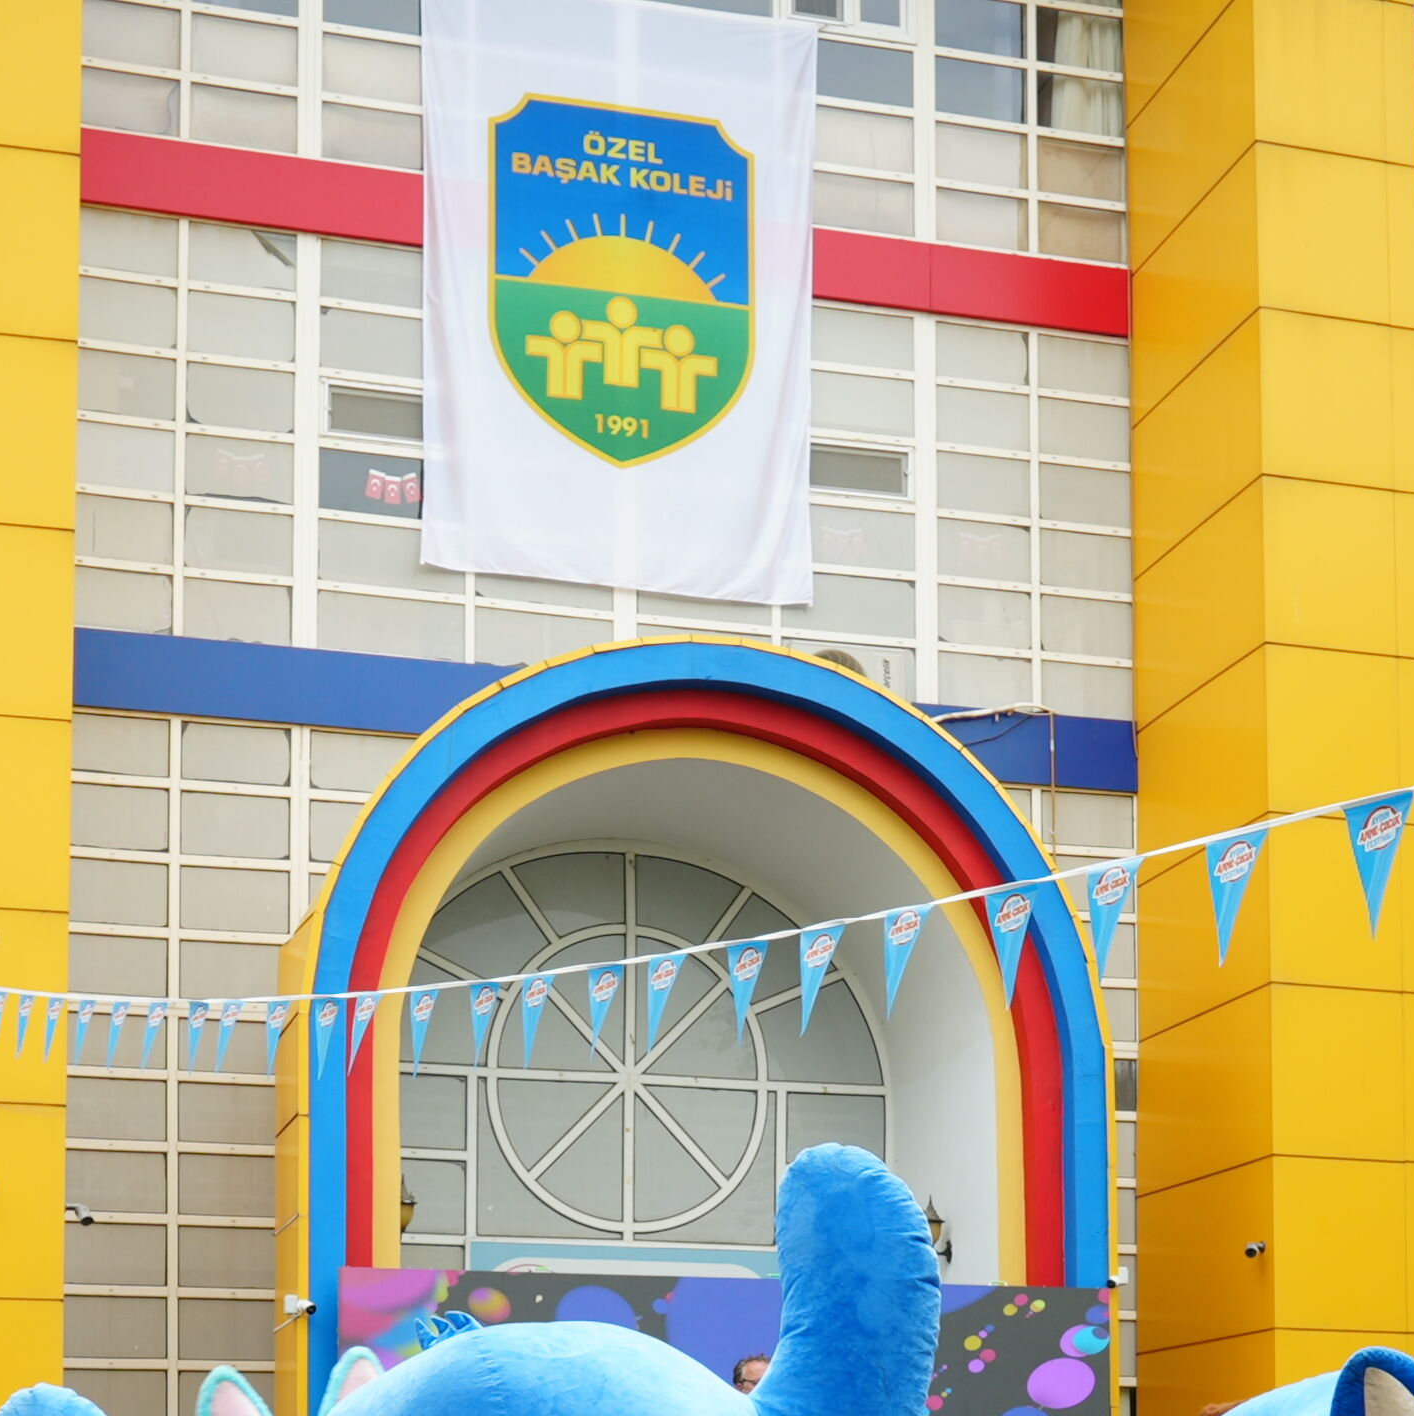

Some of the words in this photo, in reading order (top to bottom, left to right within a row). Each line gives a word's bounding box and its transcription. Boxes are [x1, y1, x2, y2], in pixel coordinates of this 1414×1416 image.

[583, 130, 663, 164] ÖZEL
[511, 152, 620, 187] BAŞAK
[594, 412, 650, 440] 1991
